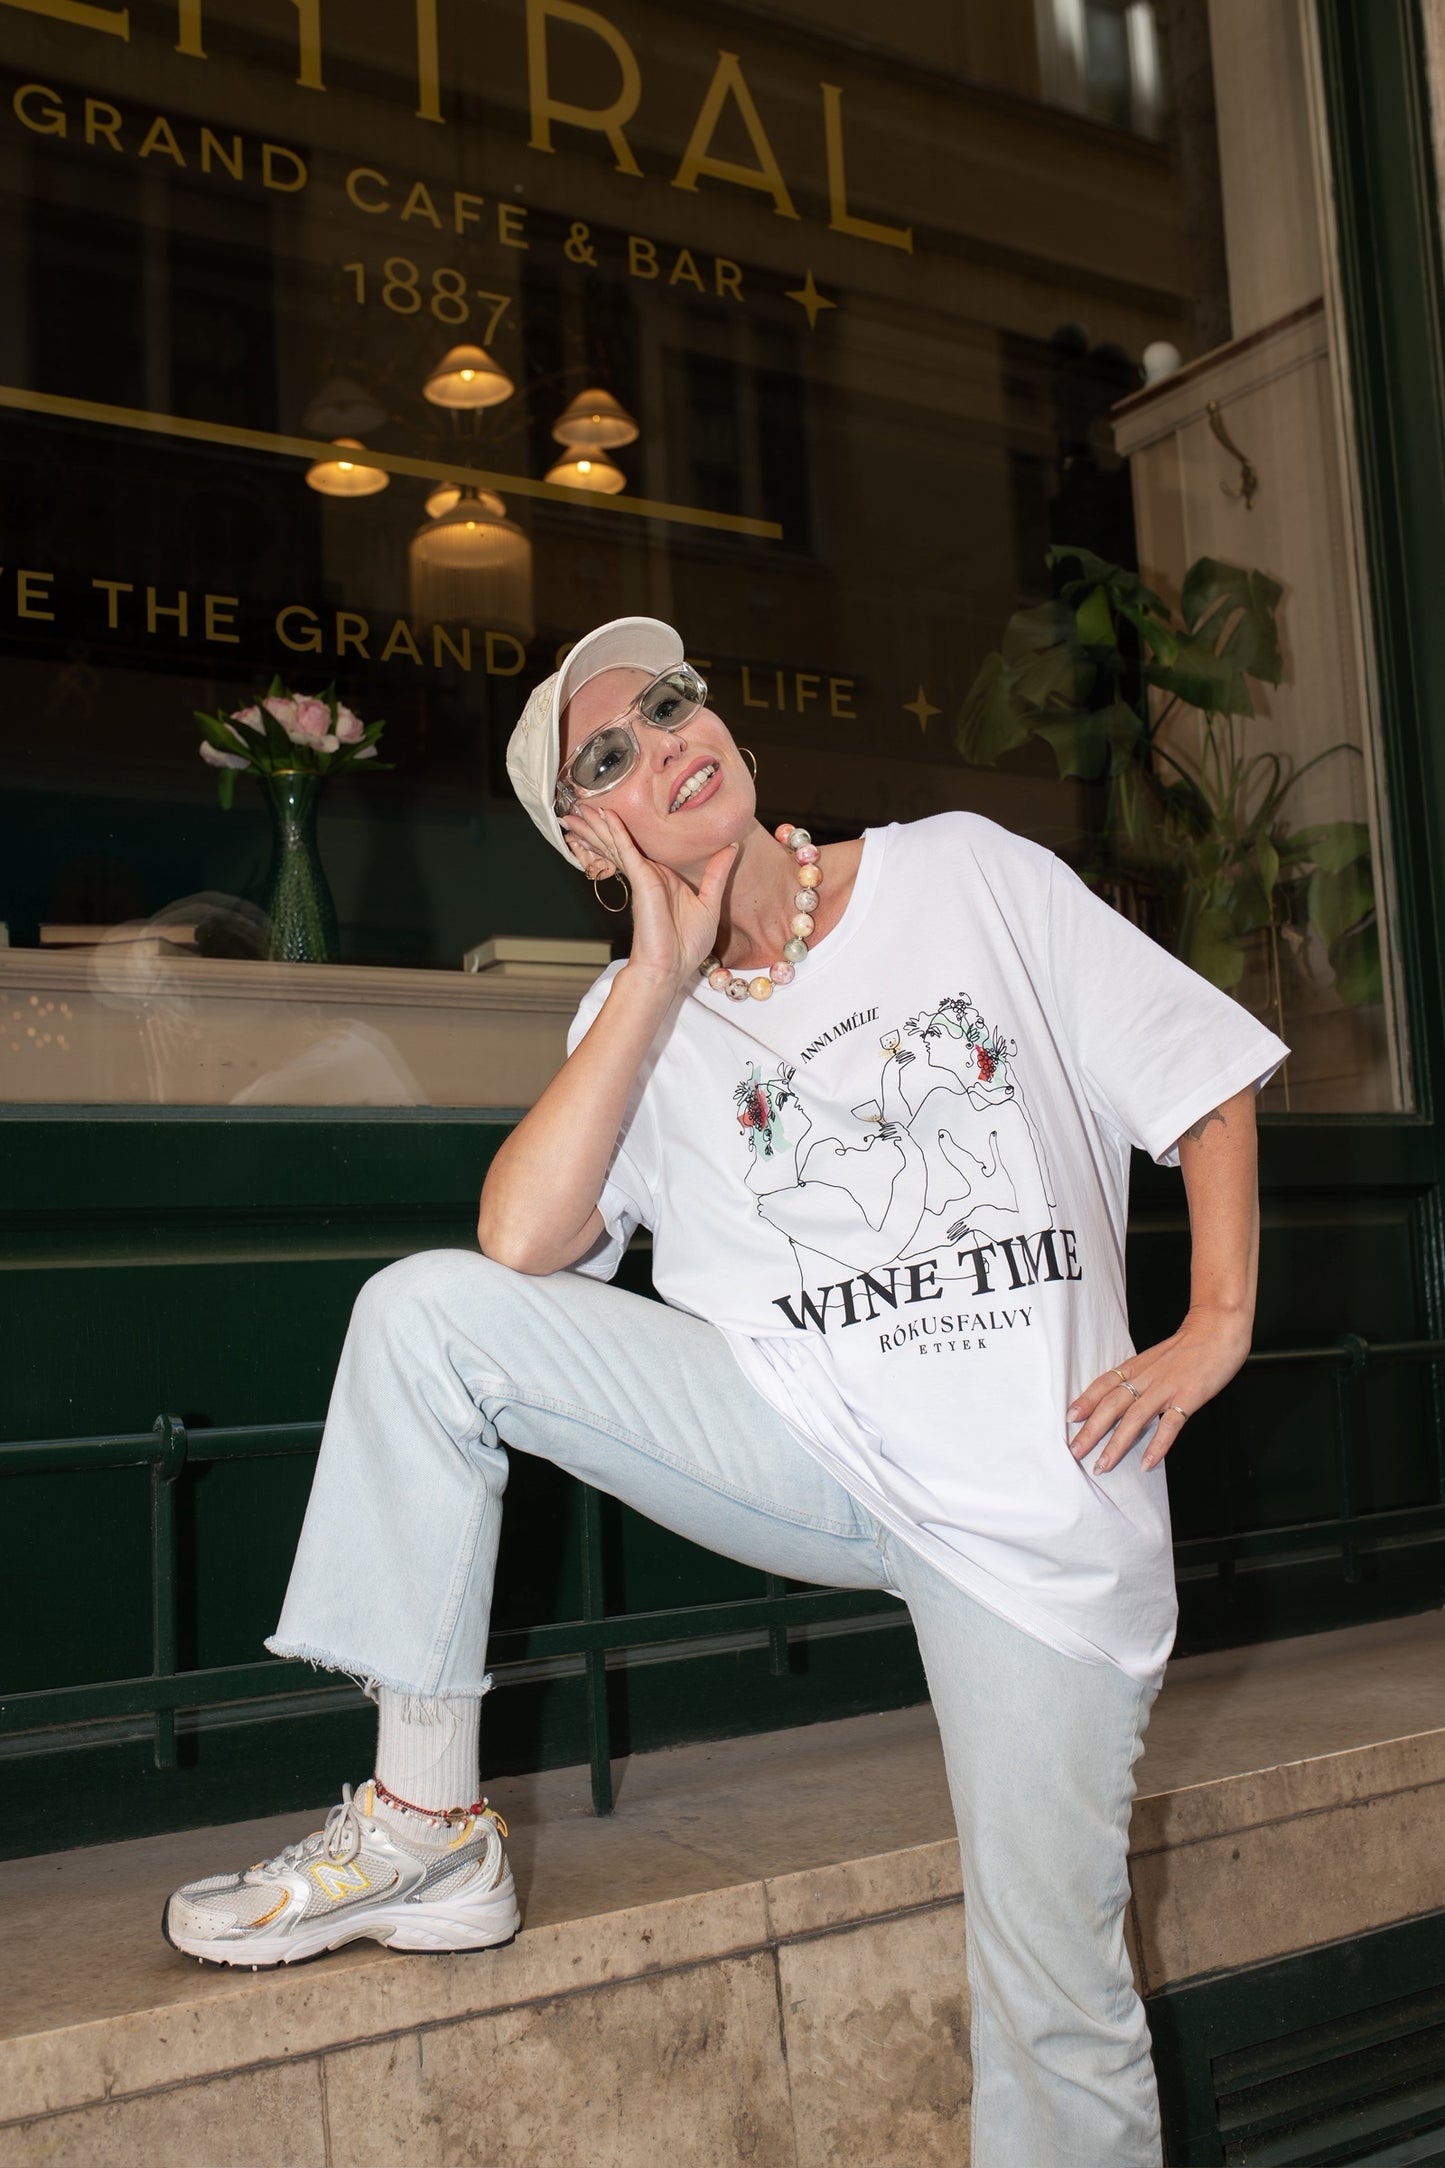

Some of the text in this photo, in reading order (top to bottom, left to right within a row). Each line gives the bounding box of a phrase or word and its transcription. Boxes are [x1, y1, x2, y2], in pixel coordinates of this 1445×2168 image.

[12, 82, 746, 302] GRAND CAFE & BAR
[343, 256, 513, 347] 1887
[0, 566, 56, 622] E
[91, 577, 241, 644] THE
[274, 604, 527, 677] GRAND
[741, 665, 857, 720] LIFE
[771, 1229, 1083, 1336] WINE TIME
[878, 1306, 1034, 1354] RÓKUSFALVY
[918, 1338, 988, 1356] ETYEK
